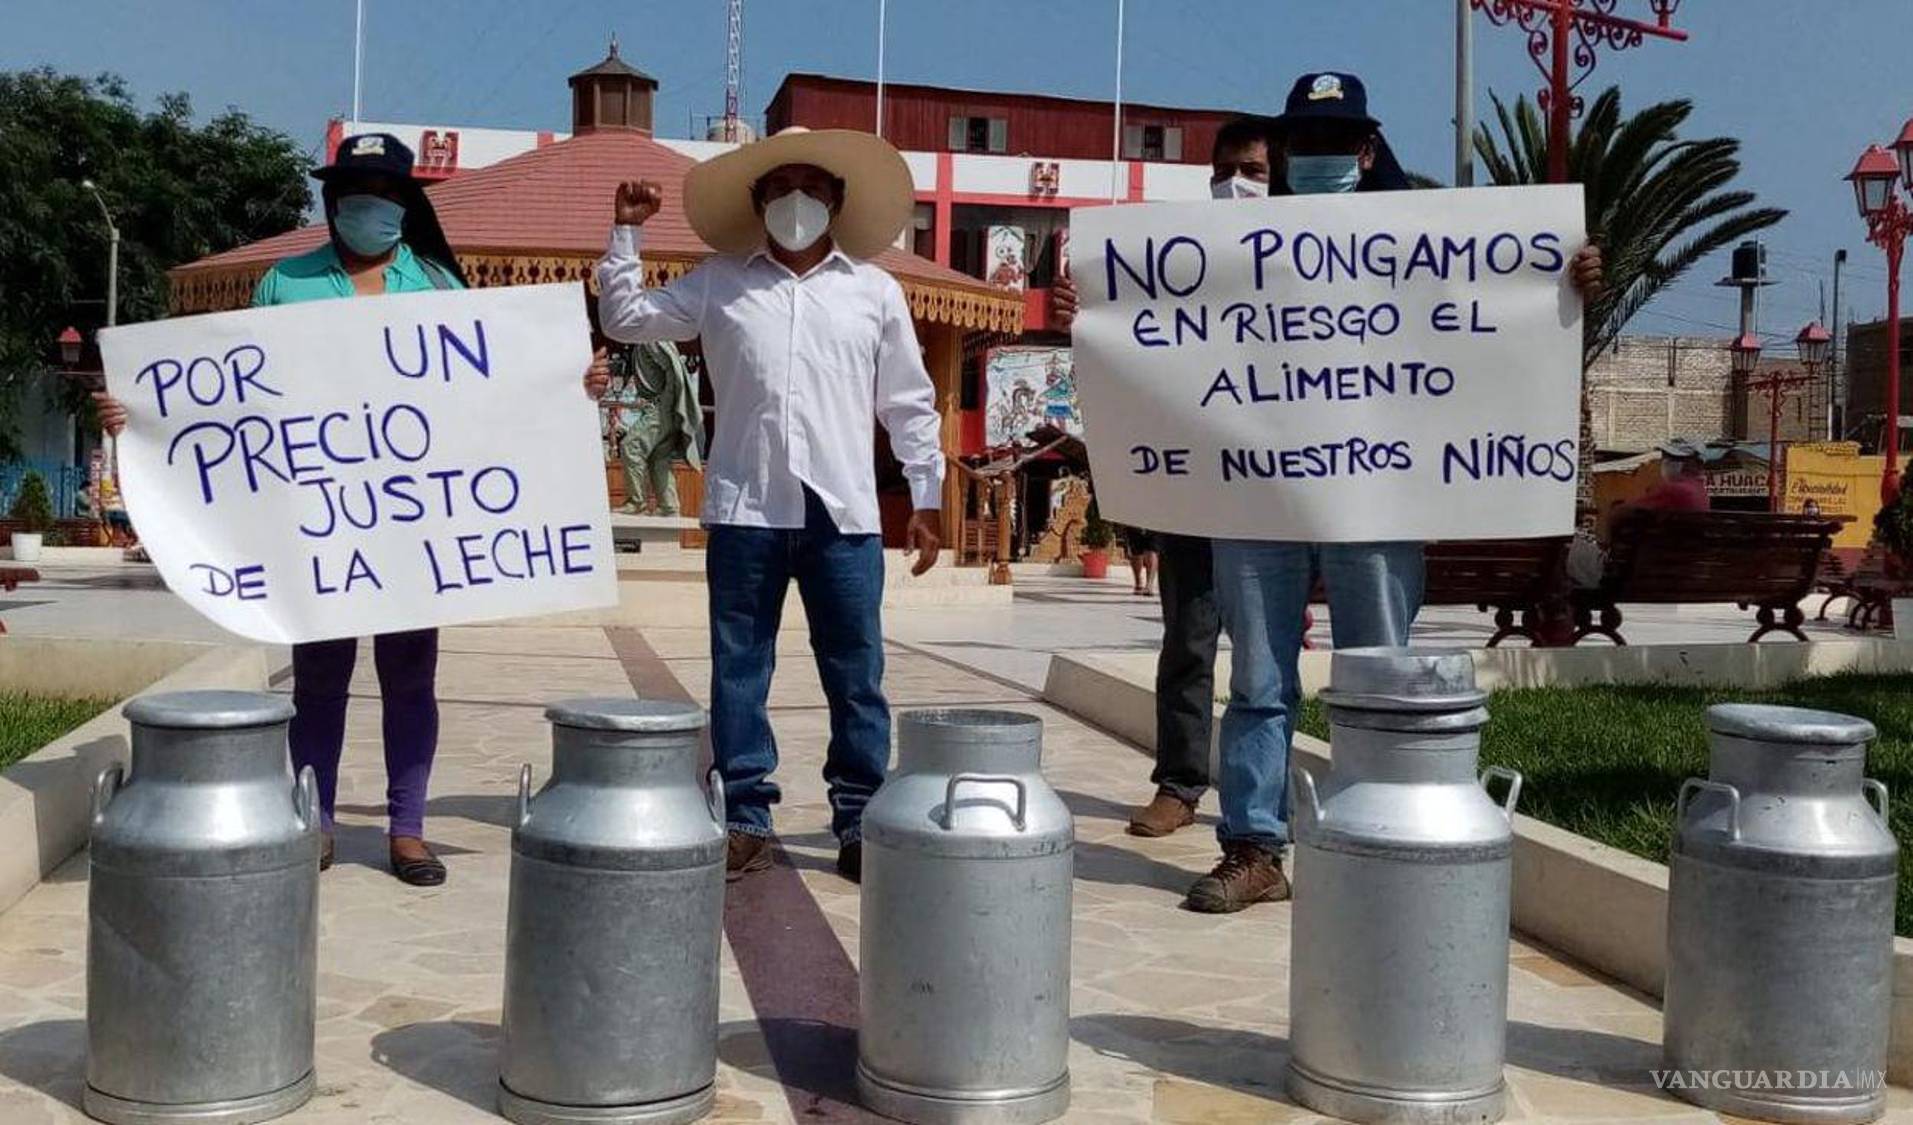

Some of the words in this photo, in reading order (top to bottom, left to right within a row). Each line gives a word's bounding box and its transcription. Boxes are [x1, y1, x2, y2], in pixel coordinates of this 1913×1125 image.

[1105, 236, 1207, 301] NO
[1240, 229, 1564, 290] PONGAMOS
[1133, 304, 1208, 347] EN
[1432, 300, 1497, 333] EL
[135, 343, 283, 417] POR
[384, 320, 490, 381] UN
[1131, 444, 1190, 476] DE
[1221, 437, 1412, 481] NUESTROS
[299, 466, 519, 537] JUSTO
[189, 563, 267, 600] DE
[313, 549, 382, 595] LA
[424, 524, 594, 594] LECHE
